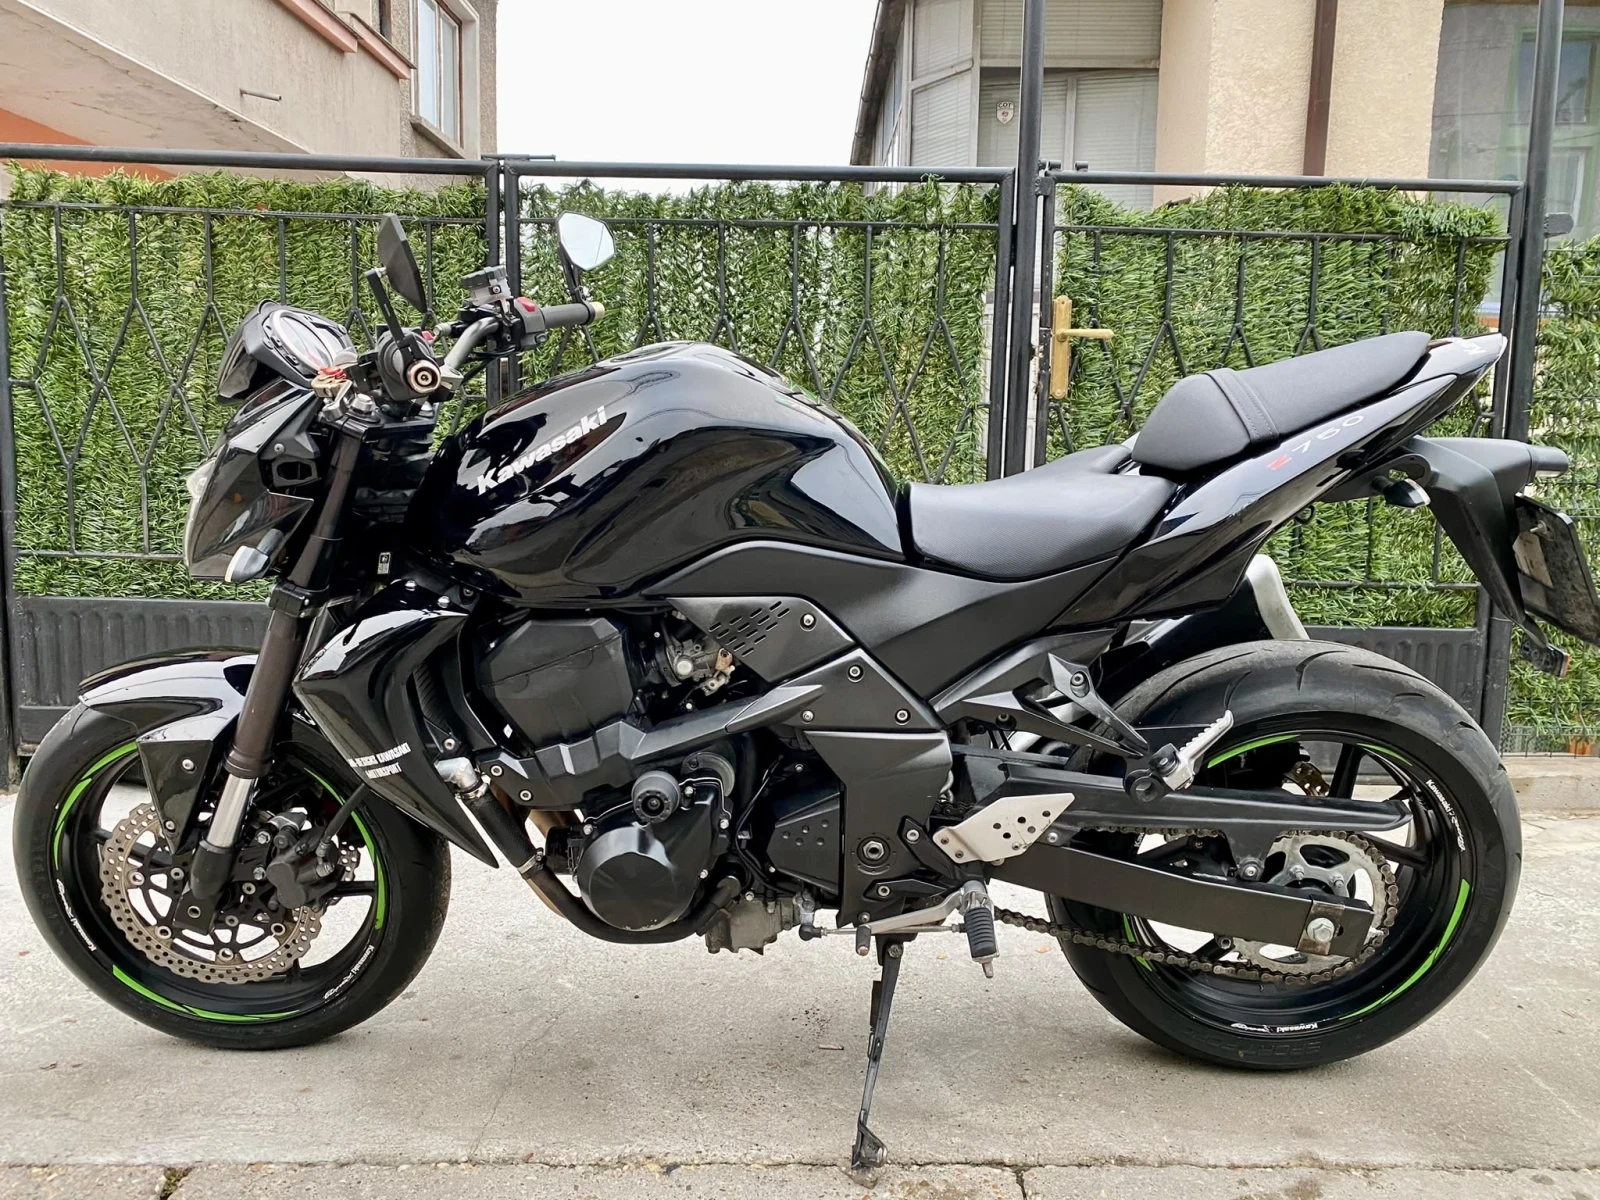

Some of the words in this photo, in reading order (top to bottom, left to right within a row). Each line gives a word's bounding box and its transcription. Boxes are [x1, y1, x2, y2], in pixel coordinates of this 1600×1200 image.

[476, 405, 608, 496] Kawasaki
[376, 742, 412, 763] KAWASAKI
[1425, 779, 1453, 813] Kawasaki
[70, 917, 97, 952] Kawasaki
[350, 944, 375, 974] Kawasaki
[1276, 1022, 1319, 1033] Kawasaki
